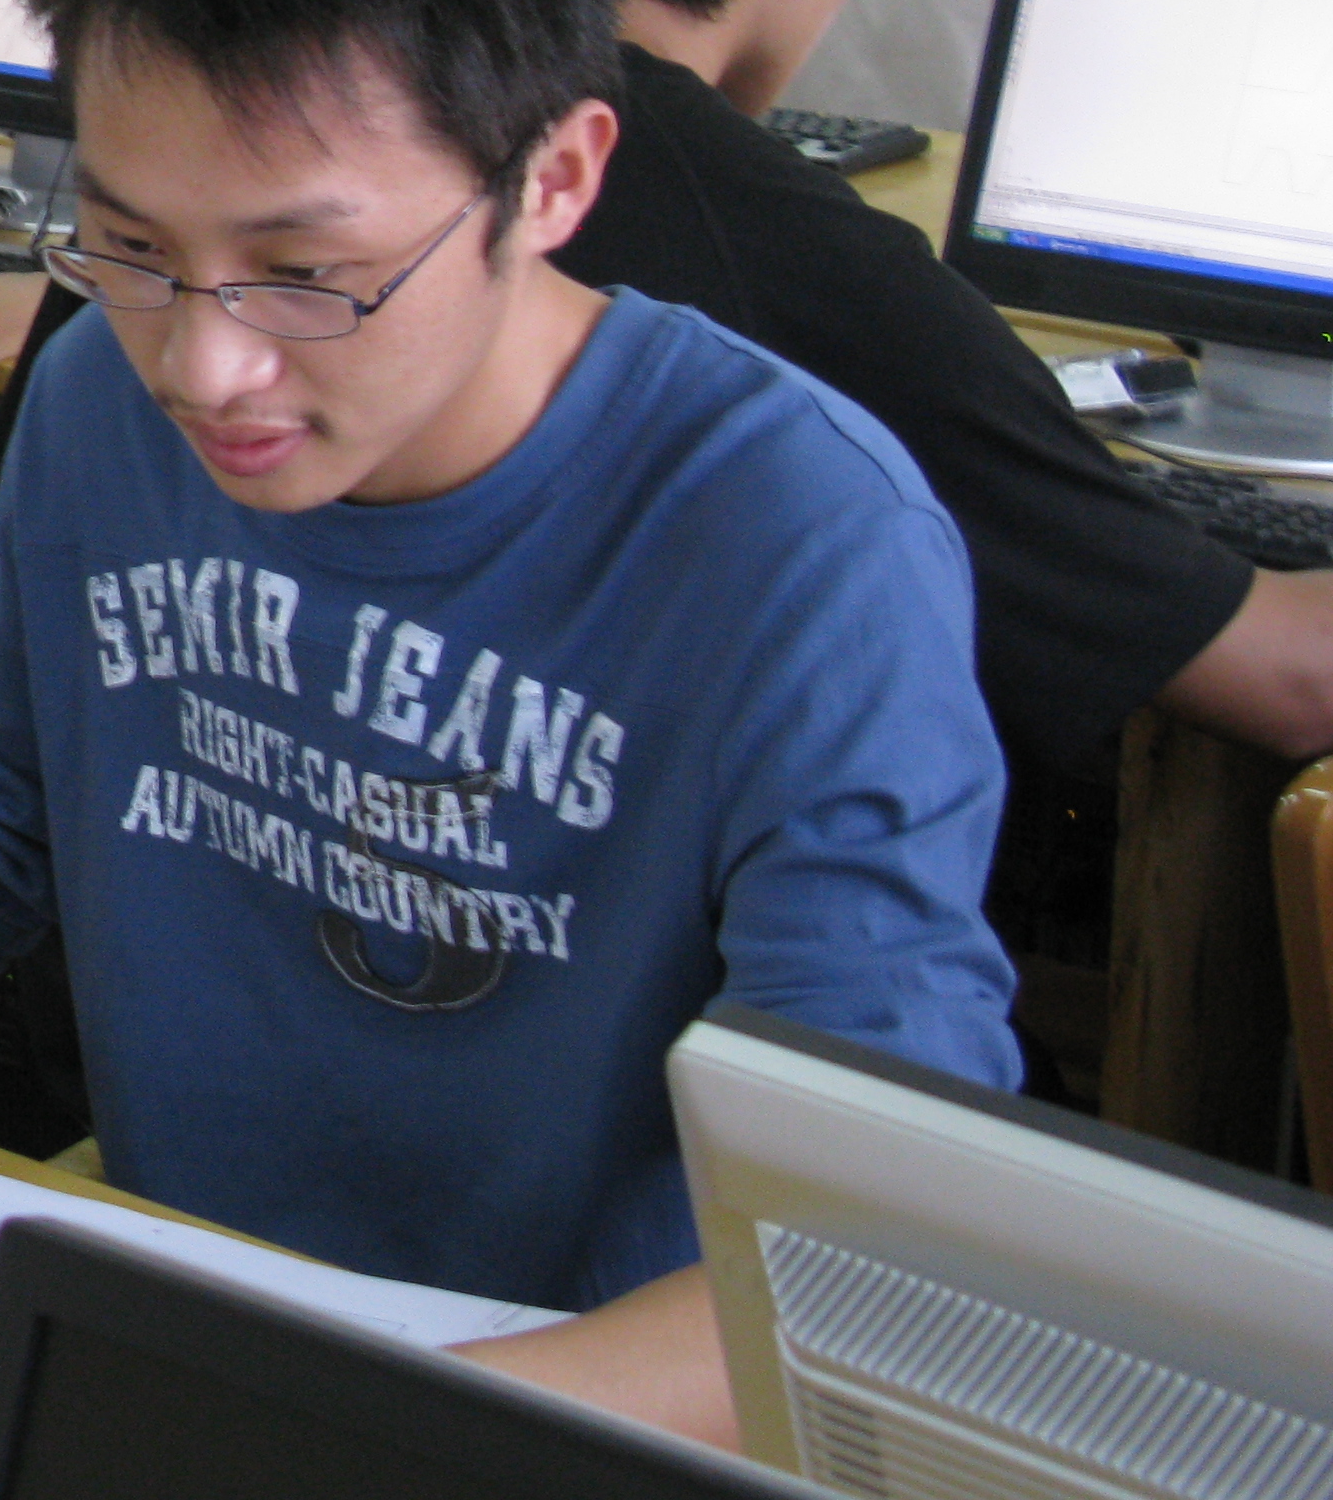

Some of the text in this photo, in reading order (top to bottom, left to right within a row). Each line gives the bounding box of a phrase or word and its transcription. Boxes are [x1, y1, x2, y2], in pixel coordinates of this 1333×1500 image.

[86, 556, 625, 831] SEMIR JEANS
[120, 764, 575, 963] AUTUMN COUNTRY
